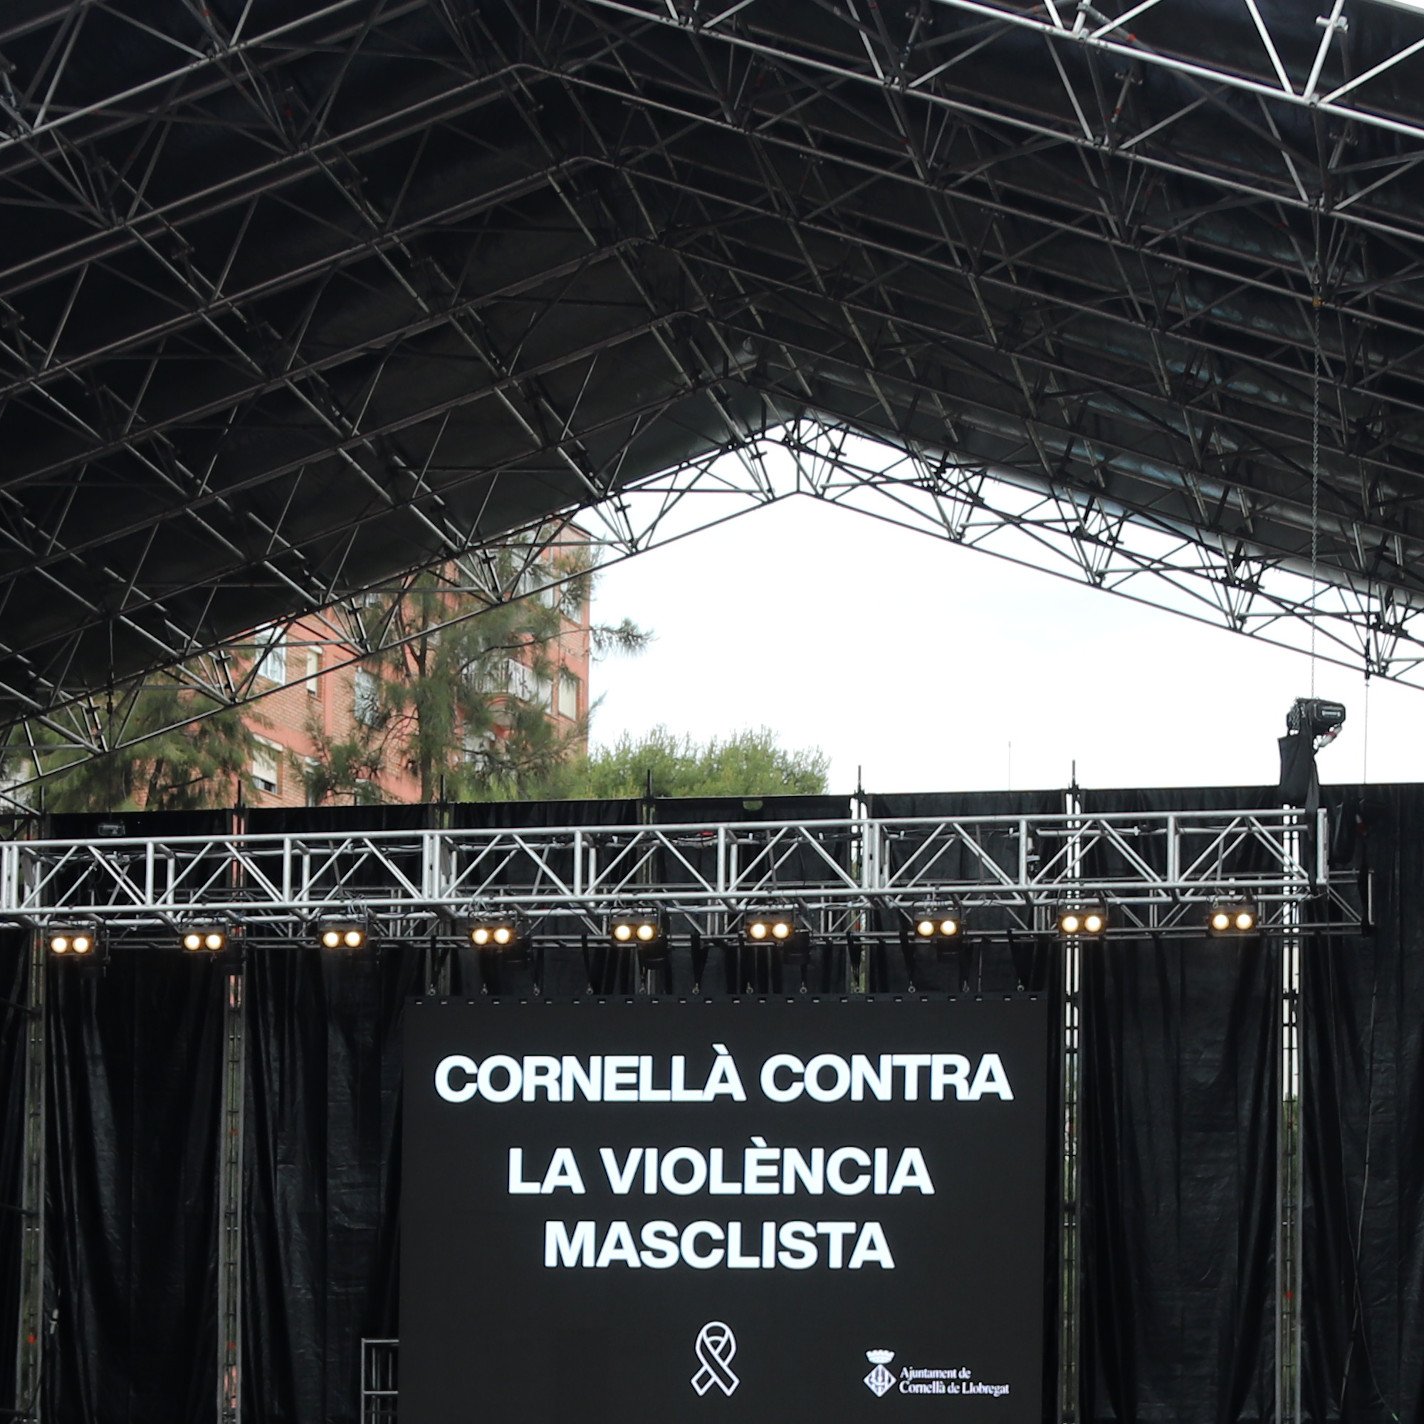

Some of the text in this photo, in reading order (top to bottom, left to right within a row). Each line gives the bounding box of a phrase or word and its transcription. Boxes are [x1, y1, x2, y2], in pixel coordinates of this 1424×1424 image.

[434, 1044, 1014, 1102] CORNELLÀ CONTRA
[508, 1136, 935, 1195] LA VIOLÈNCIA
[544, 1221, 895, 1269] MASCLISTA
[899, 1366, 972, 1381] Ajuntament de
[899, 1380, 1010, 1397] Cornellà de Llobregat
